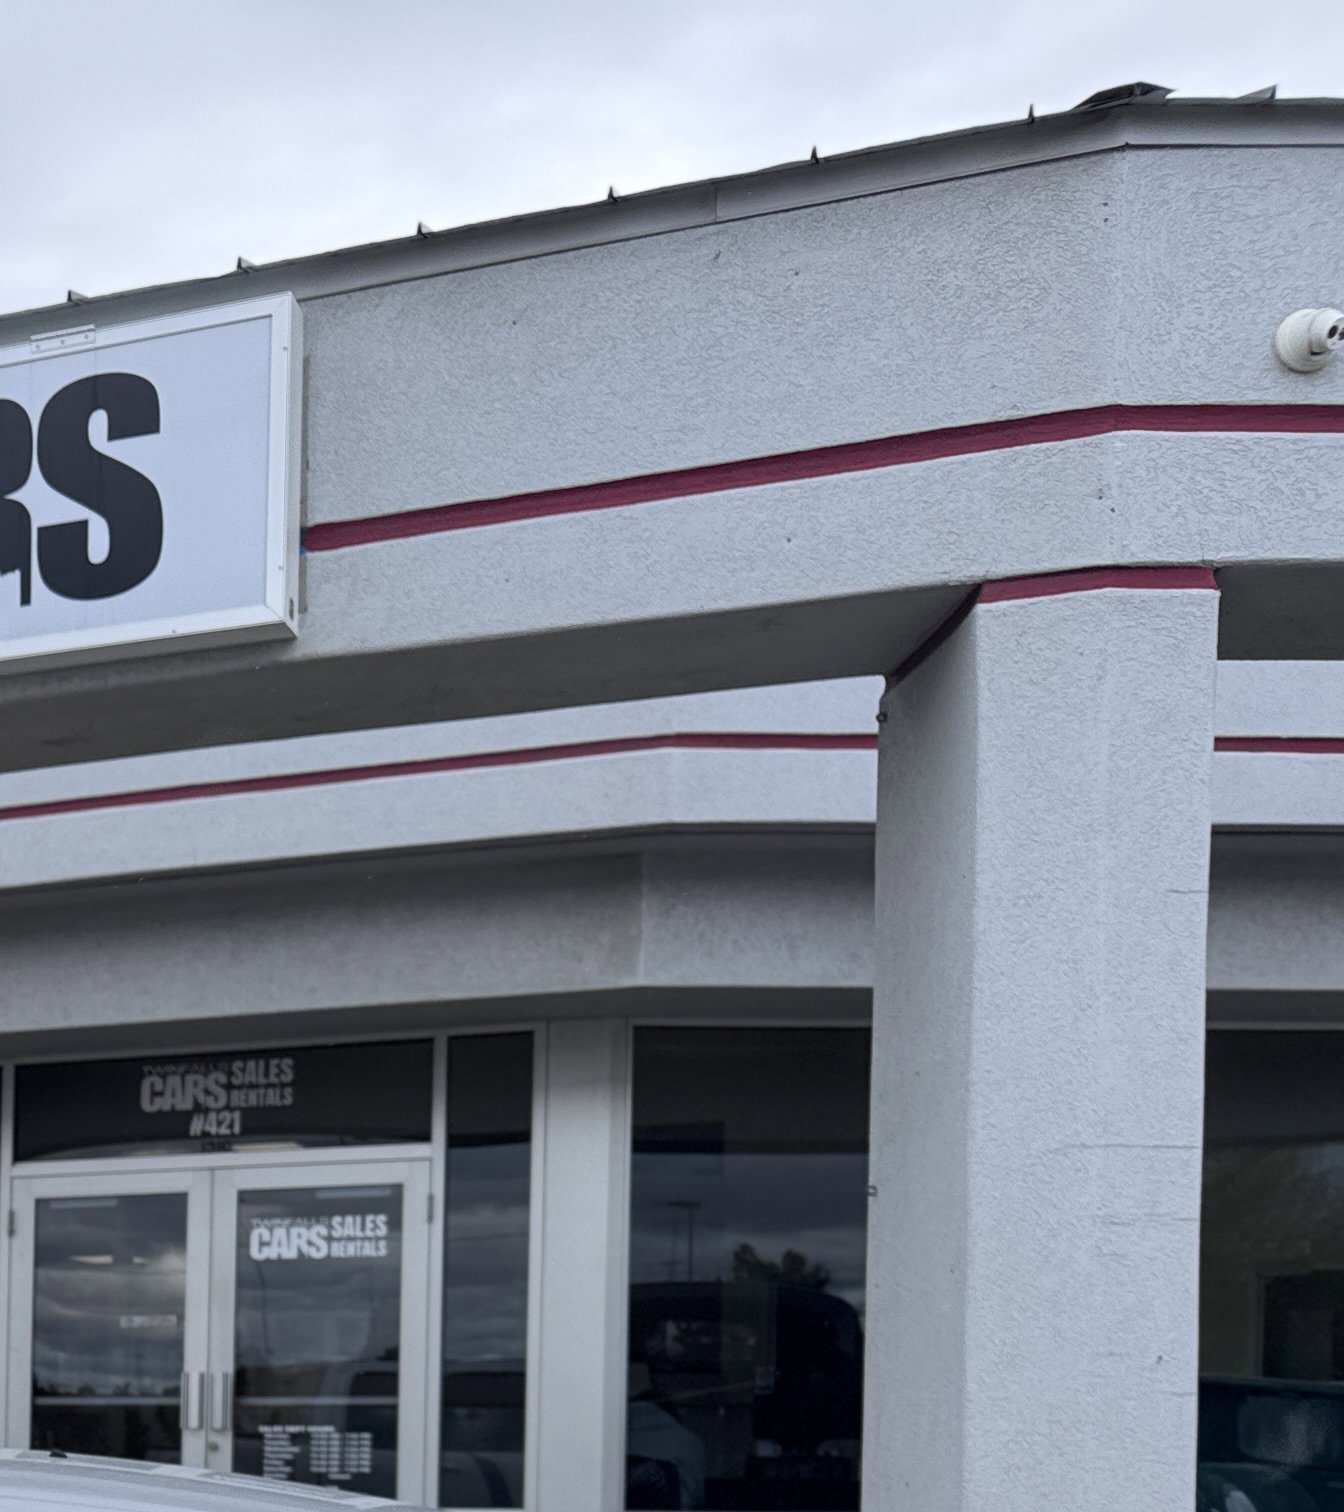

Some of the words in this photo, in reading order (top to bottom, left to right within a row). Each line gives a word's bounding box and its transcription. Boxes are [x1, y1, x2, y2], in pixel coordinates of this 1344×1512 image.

[230, 1057, 295, 1086] SALES
[140, 1071, 229, 1113] CARS
[230, 1086, 294, 1108] RENTALS
[189, 1109, 242, 1137] #421
[330, 1213, 389, 1238] SALES
[249, 1224, 329, 1261] CARS
[329, 1239, 388, 1258] RENTALS
